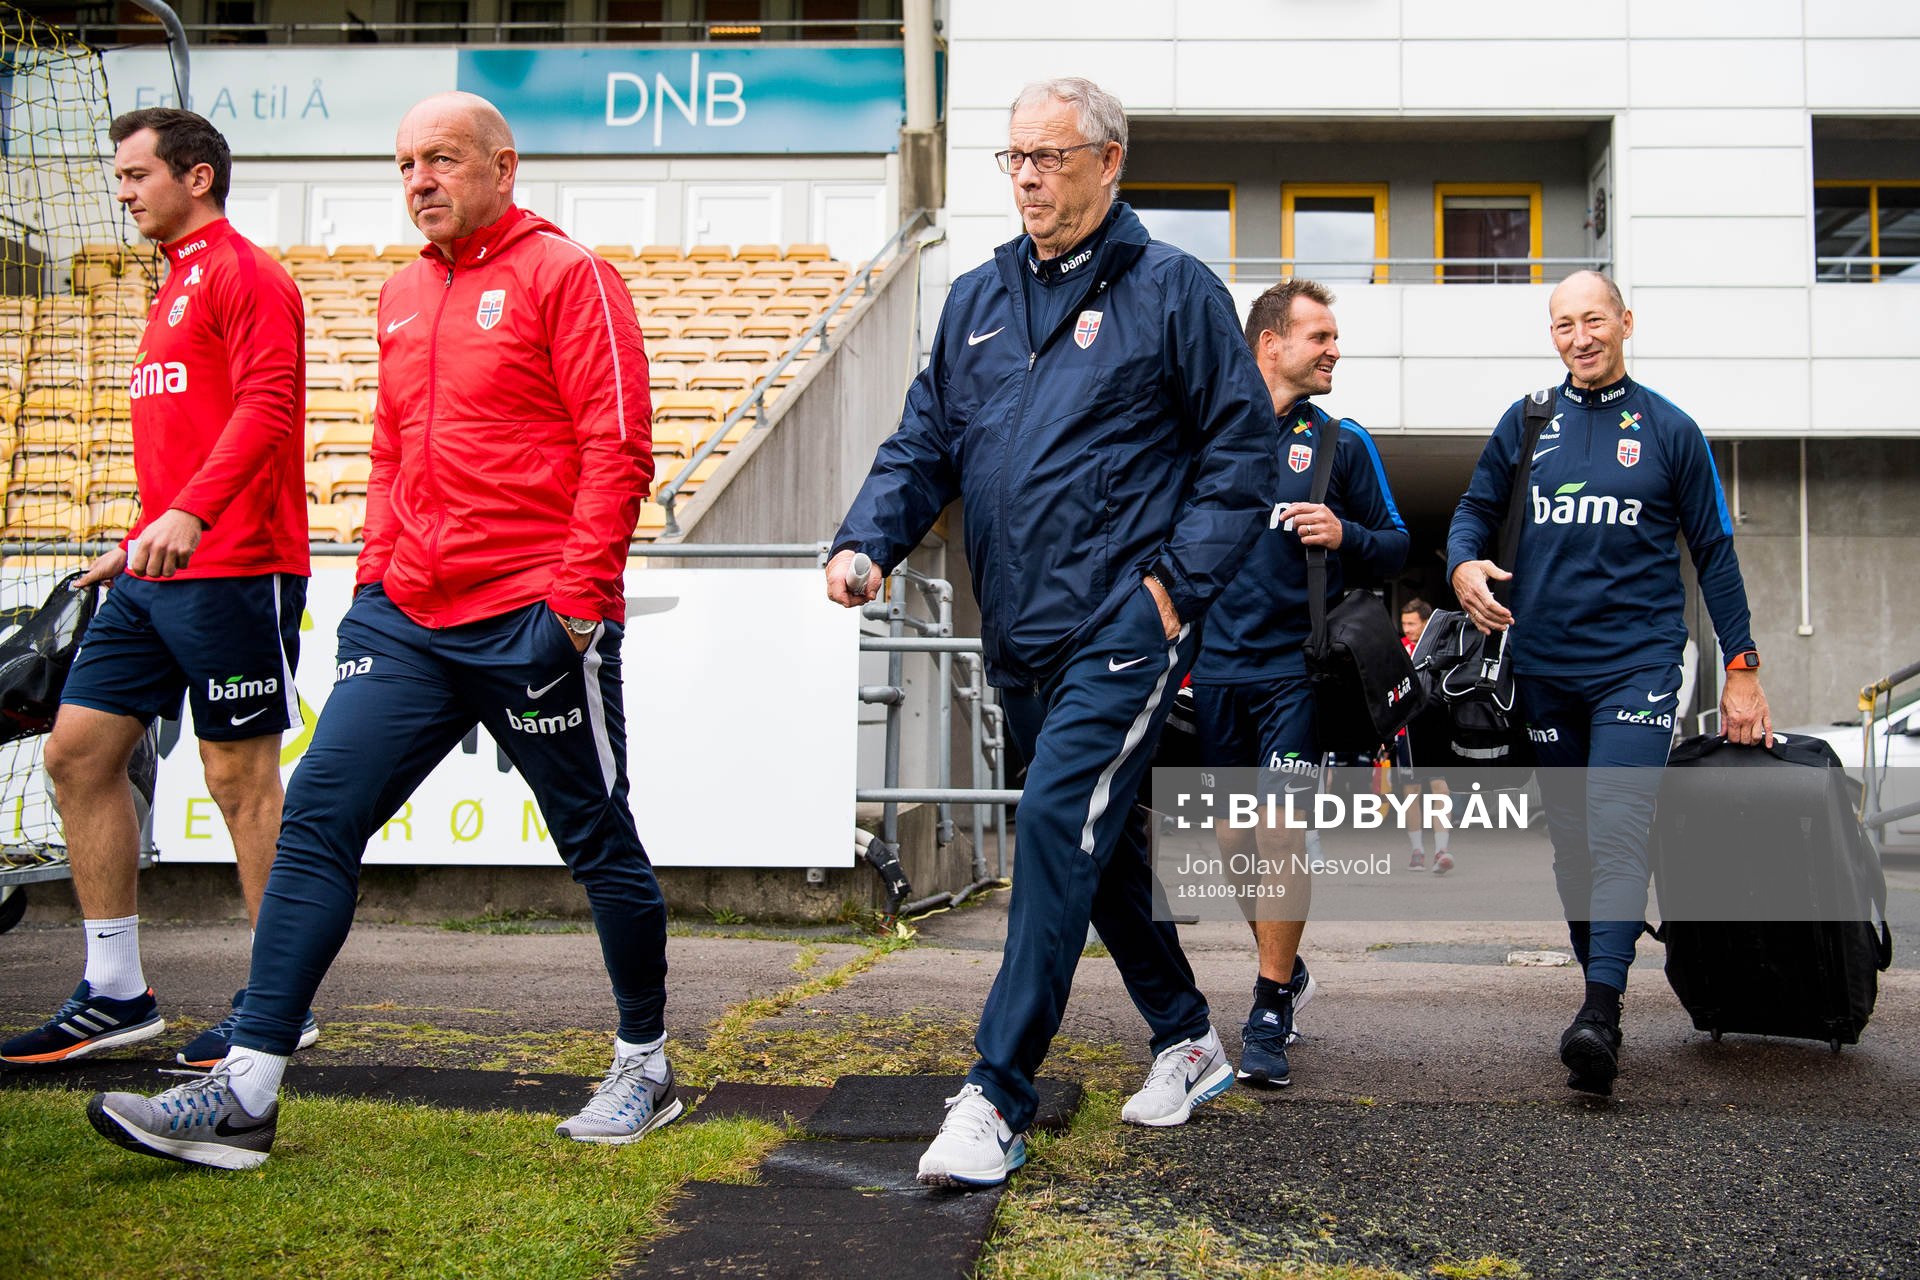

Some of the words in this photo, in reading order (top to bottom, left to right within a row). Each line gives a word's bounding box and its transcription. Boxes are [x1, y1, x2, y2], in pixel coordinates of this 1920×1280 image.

[209, 87, 237, 119] A
[252, 85, 288, 120] til
[301, 77, 329, 119] Å
[606, 52, 747, 147] DNB
